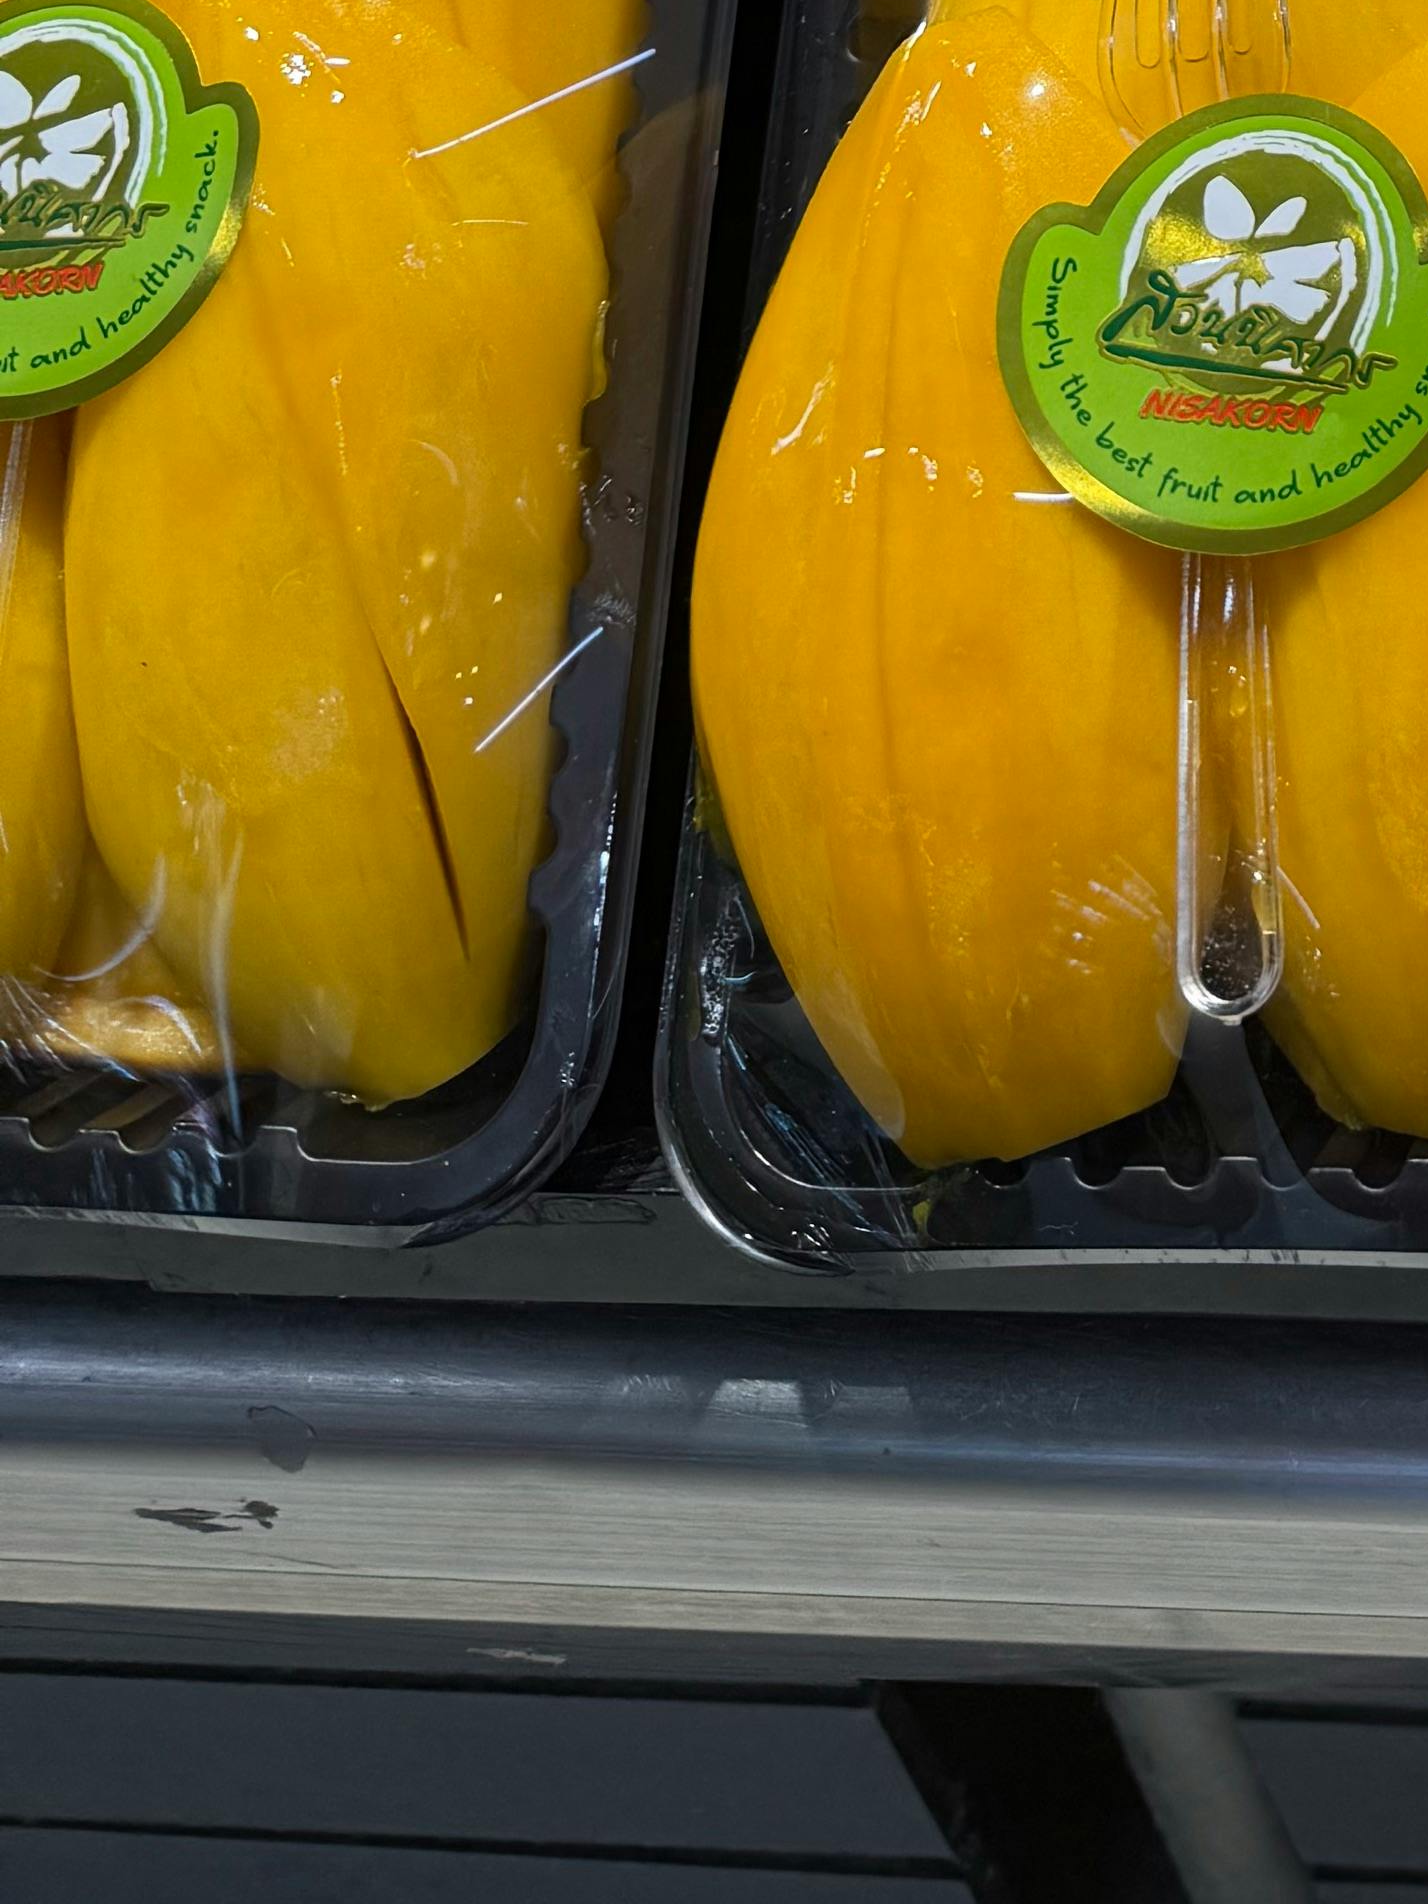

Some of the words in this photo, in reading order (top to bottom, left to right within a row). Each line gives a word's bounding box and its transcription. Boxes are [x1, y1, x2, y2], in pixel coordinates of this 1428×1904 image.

[31, 326, 91, 370] and
[98, 243, 196, 341] healthy
[186, 129, 220, 234] snack.
[1033, 254, 1078, 370] Simply
[1062, 374, 1091, 426] the
[1097, 426, 1152, 479] best
[1157, 469, 1223, 503] fruit
[1235, 474, 1302, 503] and
[1310, 404, 1422, 488] healthy
[1139, 392, 1323, 435] NISAKORN
